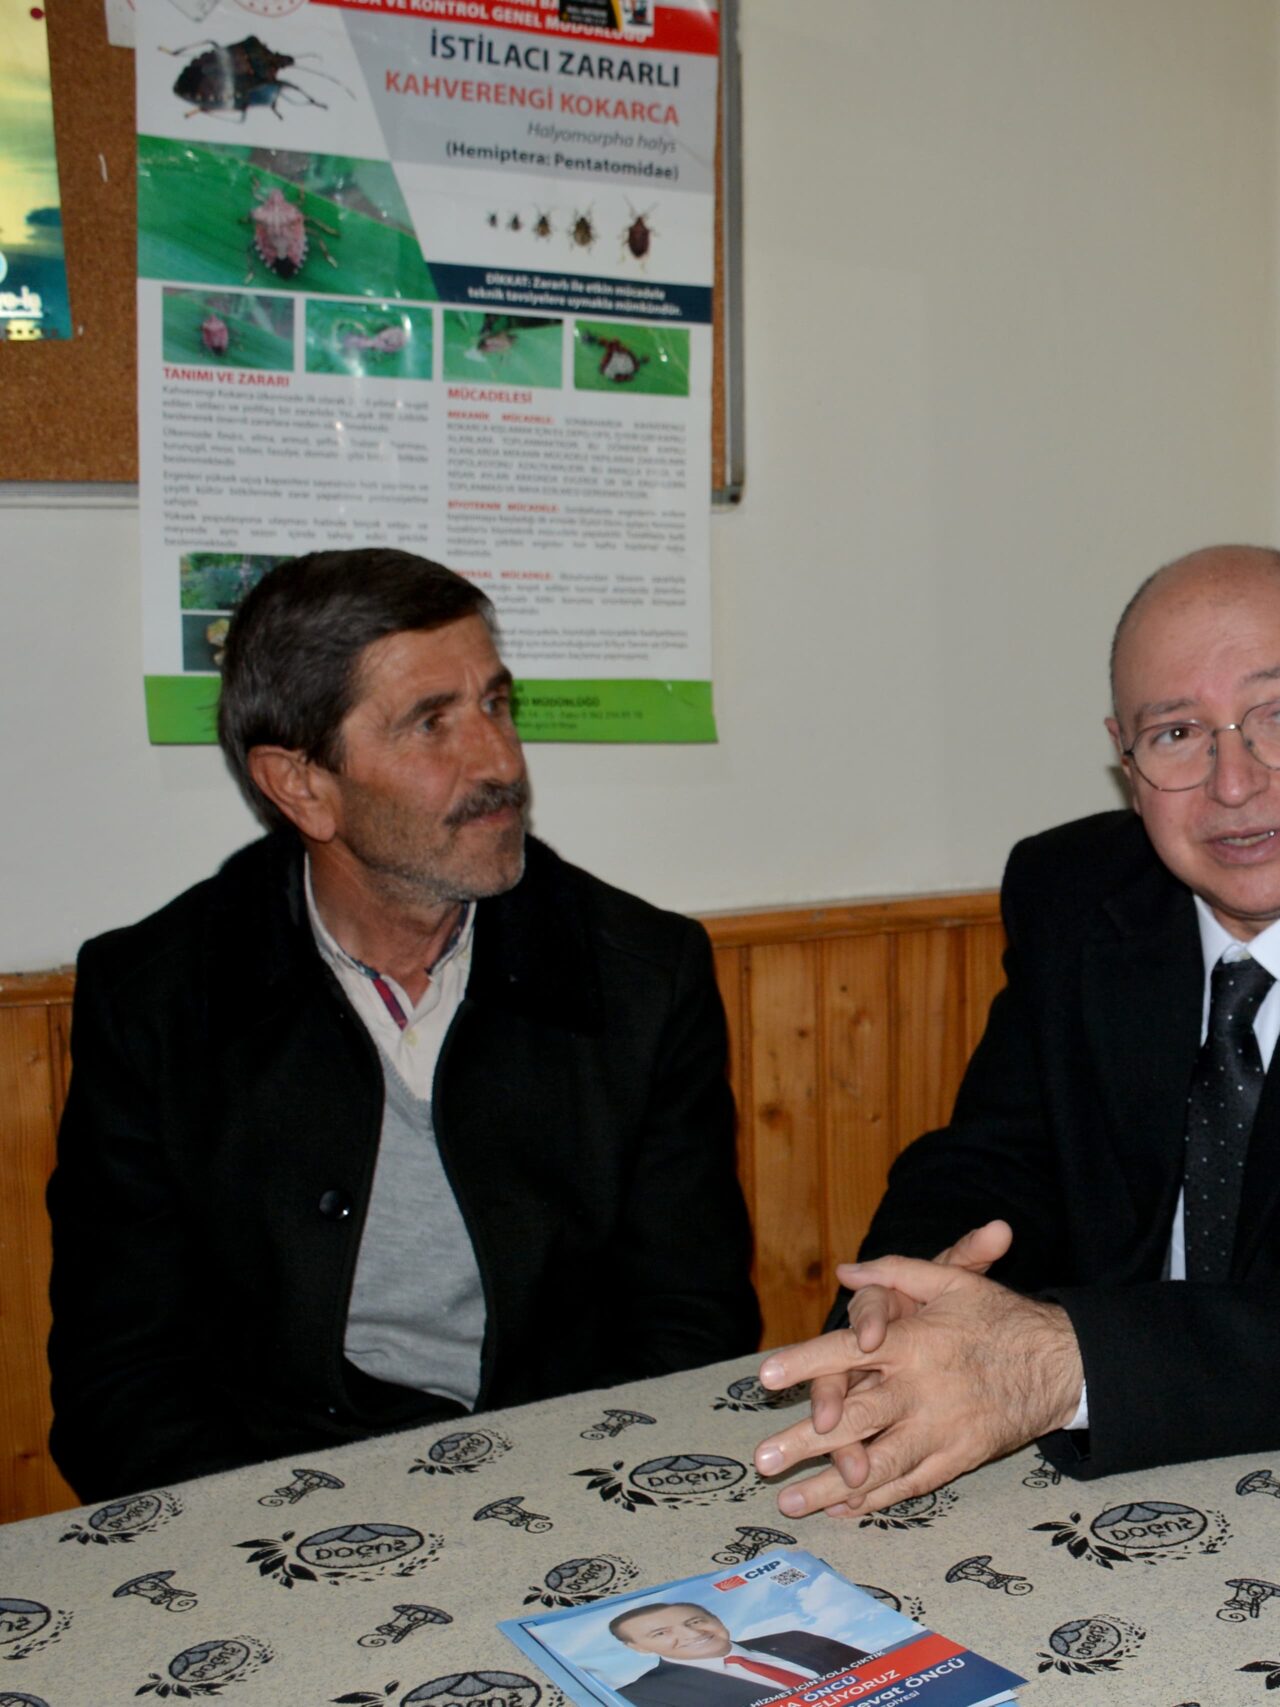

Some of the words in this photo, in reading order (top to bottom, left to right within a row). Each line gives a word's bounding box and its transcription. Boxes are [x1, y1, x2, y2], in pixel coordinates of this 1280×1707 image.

[411, 0, 488, 20] KONTROL
[492, 7, 543, 29] GENEL
[430, 28, 549, 71] İSTİLACI
[558, 50, 680, 88] ZARARLI
[385, 70, 554, 111] KAHVERENGİ
[560, 92, 680, 126] KOKARCA
[527, 121, 635, 149] Halyomorpha
[637, 134, 677, 154] halys
[446, 140, 551, 168] (Hemiptera:
[554, 154, 680, 181] Pentatomidae)
[162, 367, 214, 382] TANIMI
[216, 371, 234, 385] VE
[238, 373, 291, 388] ZARARI
[447, 387, 533, 405] MÜCADELESİ
[744, 1560, 781, 1579] CHP
[750, 1688, 796, 1707] HİZMET
[818, 1666, 851, 1682] YOLA
[850, 1650, 887, 1669] ÇIKTIK
[803, 1674, 857, 1702] ÖNCÜ
[850, 1686, 905, 1707] evat
[904, 1657, 966, 1688] ÖNCÜ
